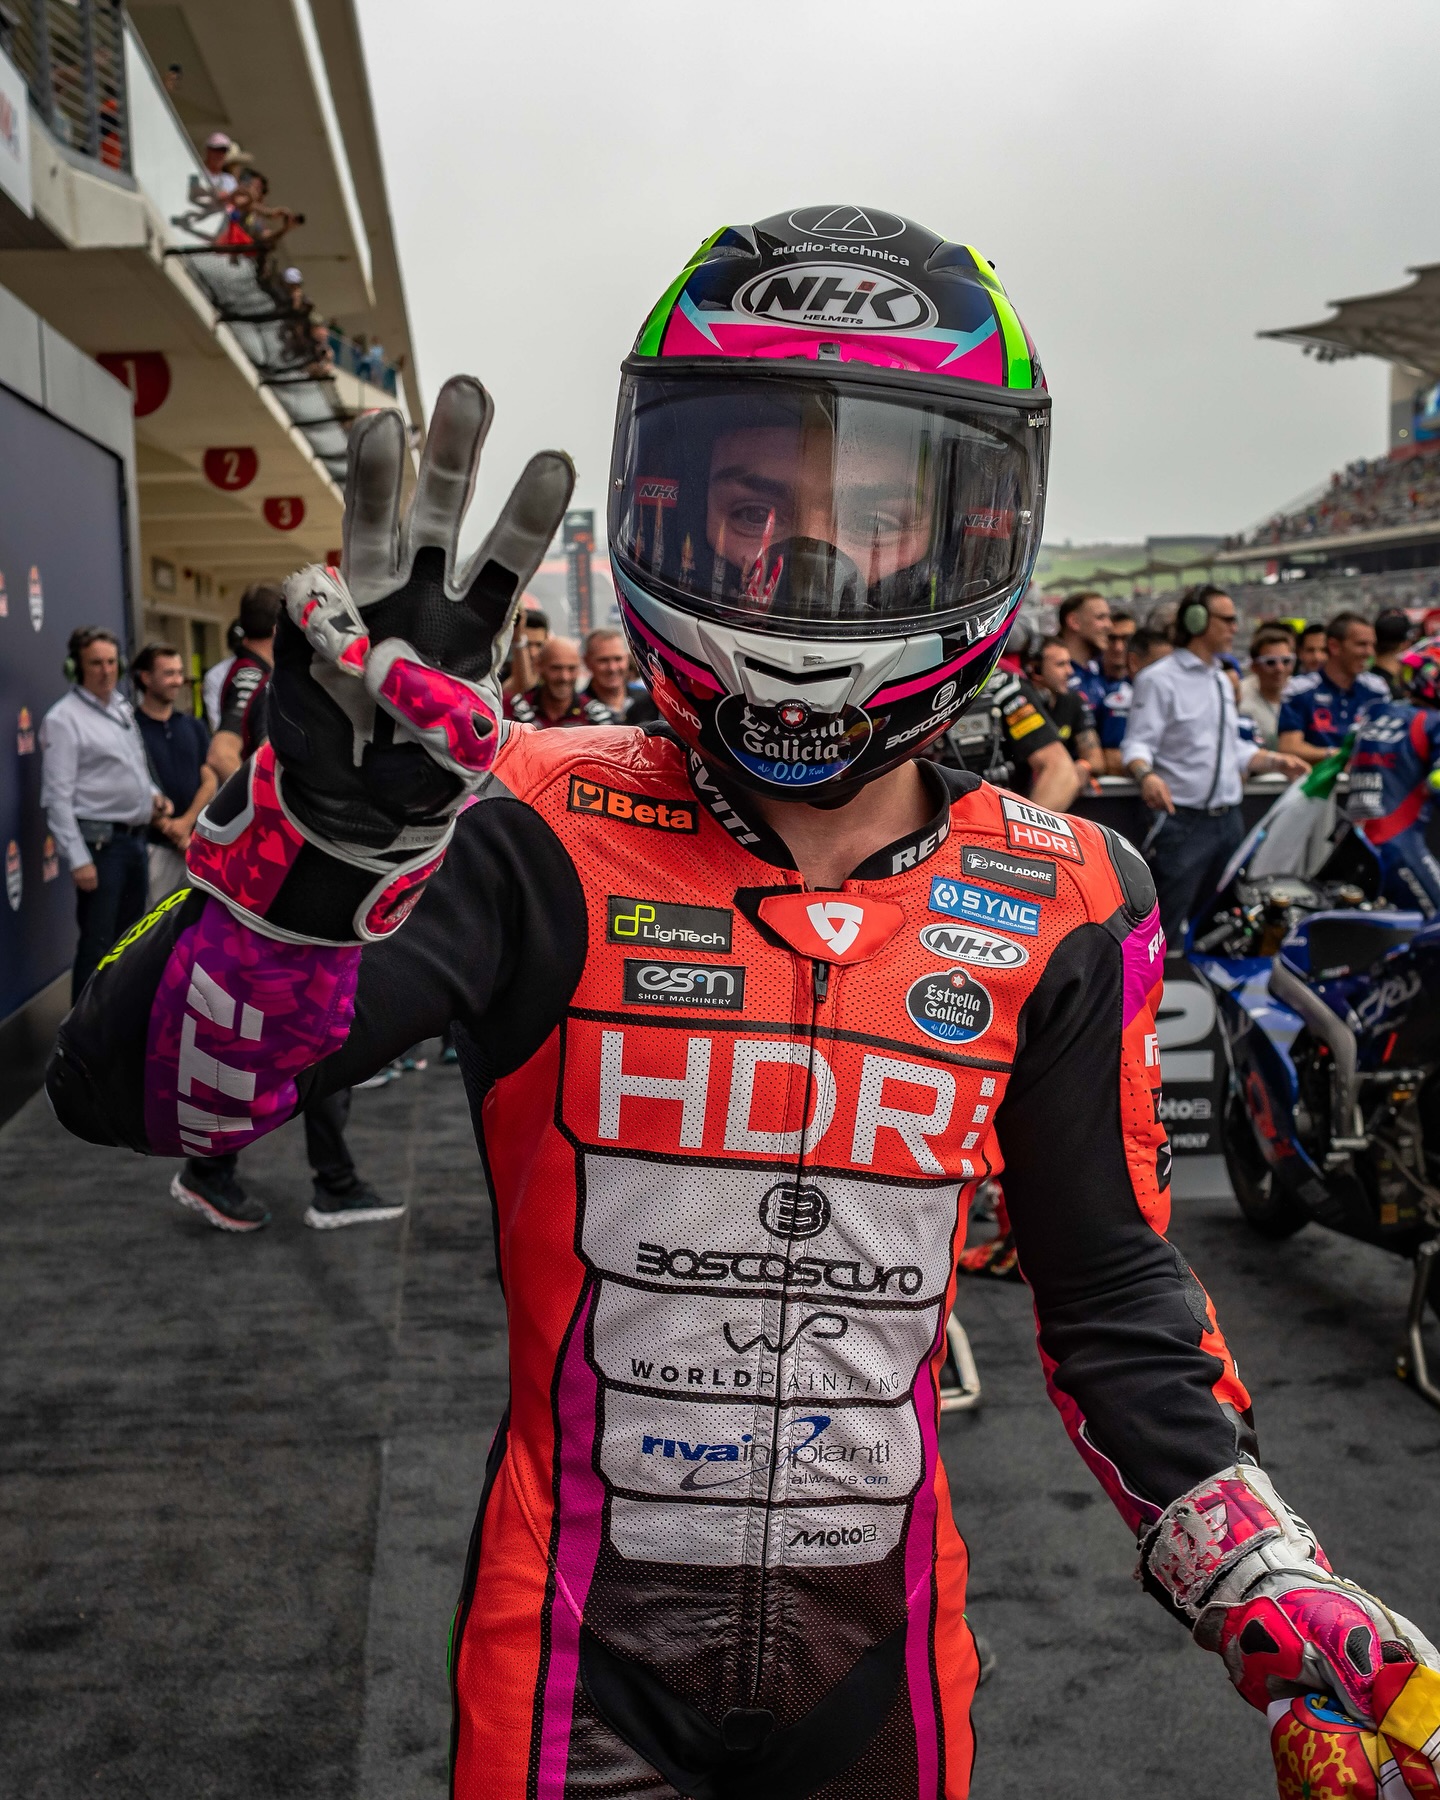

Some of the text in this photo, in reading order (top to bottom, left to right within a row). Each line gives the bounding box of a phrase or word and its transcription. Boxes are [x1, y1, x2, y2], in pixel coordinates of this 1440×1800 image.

[772, 242, 910, 266] audio-technica
[753, 276, 914, 323] NHK
[803, 314, 864, 325] HELMETS
[223, 452, 240, 484] 2
[639, 483, 679, 500] NHK
[277, 501, 293, 526] 3
[743, 730, 839, 761] Galicia
[773, 761, 807, 781] 0,0
[607, 791, 693, 829] Beta
[1016, 804, 1061, 831] TEAM
[1013, 825, 1071, 854] HDR
[989, 860, 1052, 881] FOLLADORE
[962, 890, 1038, 926] SYNC
[643, 924, 726, 946] LighTech
[997, 919, 1036, 931] MECCANICHE
[931, 931, 1013, 961] NHK
[636, 966, 735, 996] esm
[669, 995, 731, 1005] MACHINERY
[925, 983, 981, 1012] Estrella
[924, 1000, 975, 1027] Galicia
[938, 1022, 957, 1036] 0,0
[598, 1030, 957, 1177] HDR
[790, 1473, 888, 1486] always on
